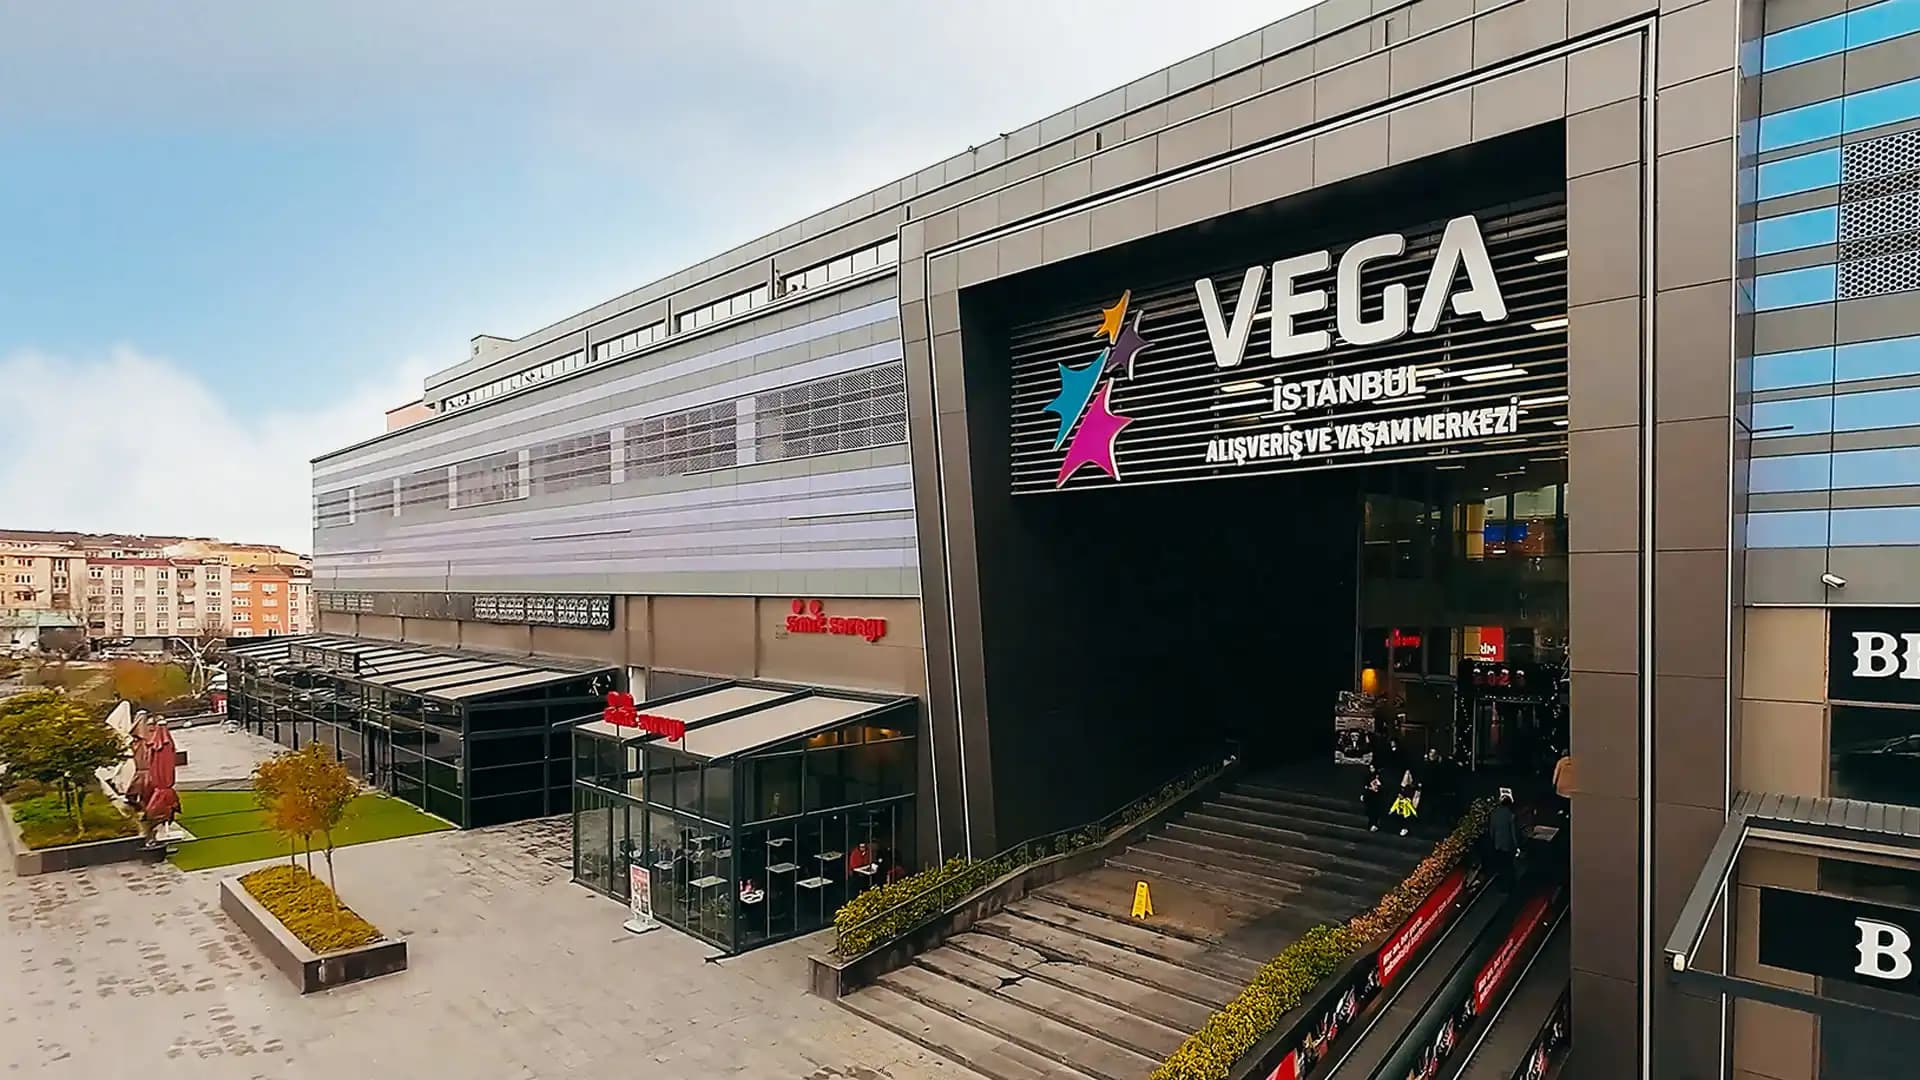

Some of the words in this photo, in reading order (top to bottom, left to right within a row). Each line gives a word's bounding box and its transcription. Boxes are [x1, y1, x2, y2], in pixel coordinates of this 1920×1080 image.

[1194, 214, 1508, 367] VEGA
[1273, 366, 1426, 411] İSTANBUL
[1205, 427, 1304, 465] ALIŞVERİŞ
[1306, 428, 1332, 453] VE
[1334, 419, 1410, 455] YAŞAM
[1411, 396, 1518, 443] MERKEZİ
